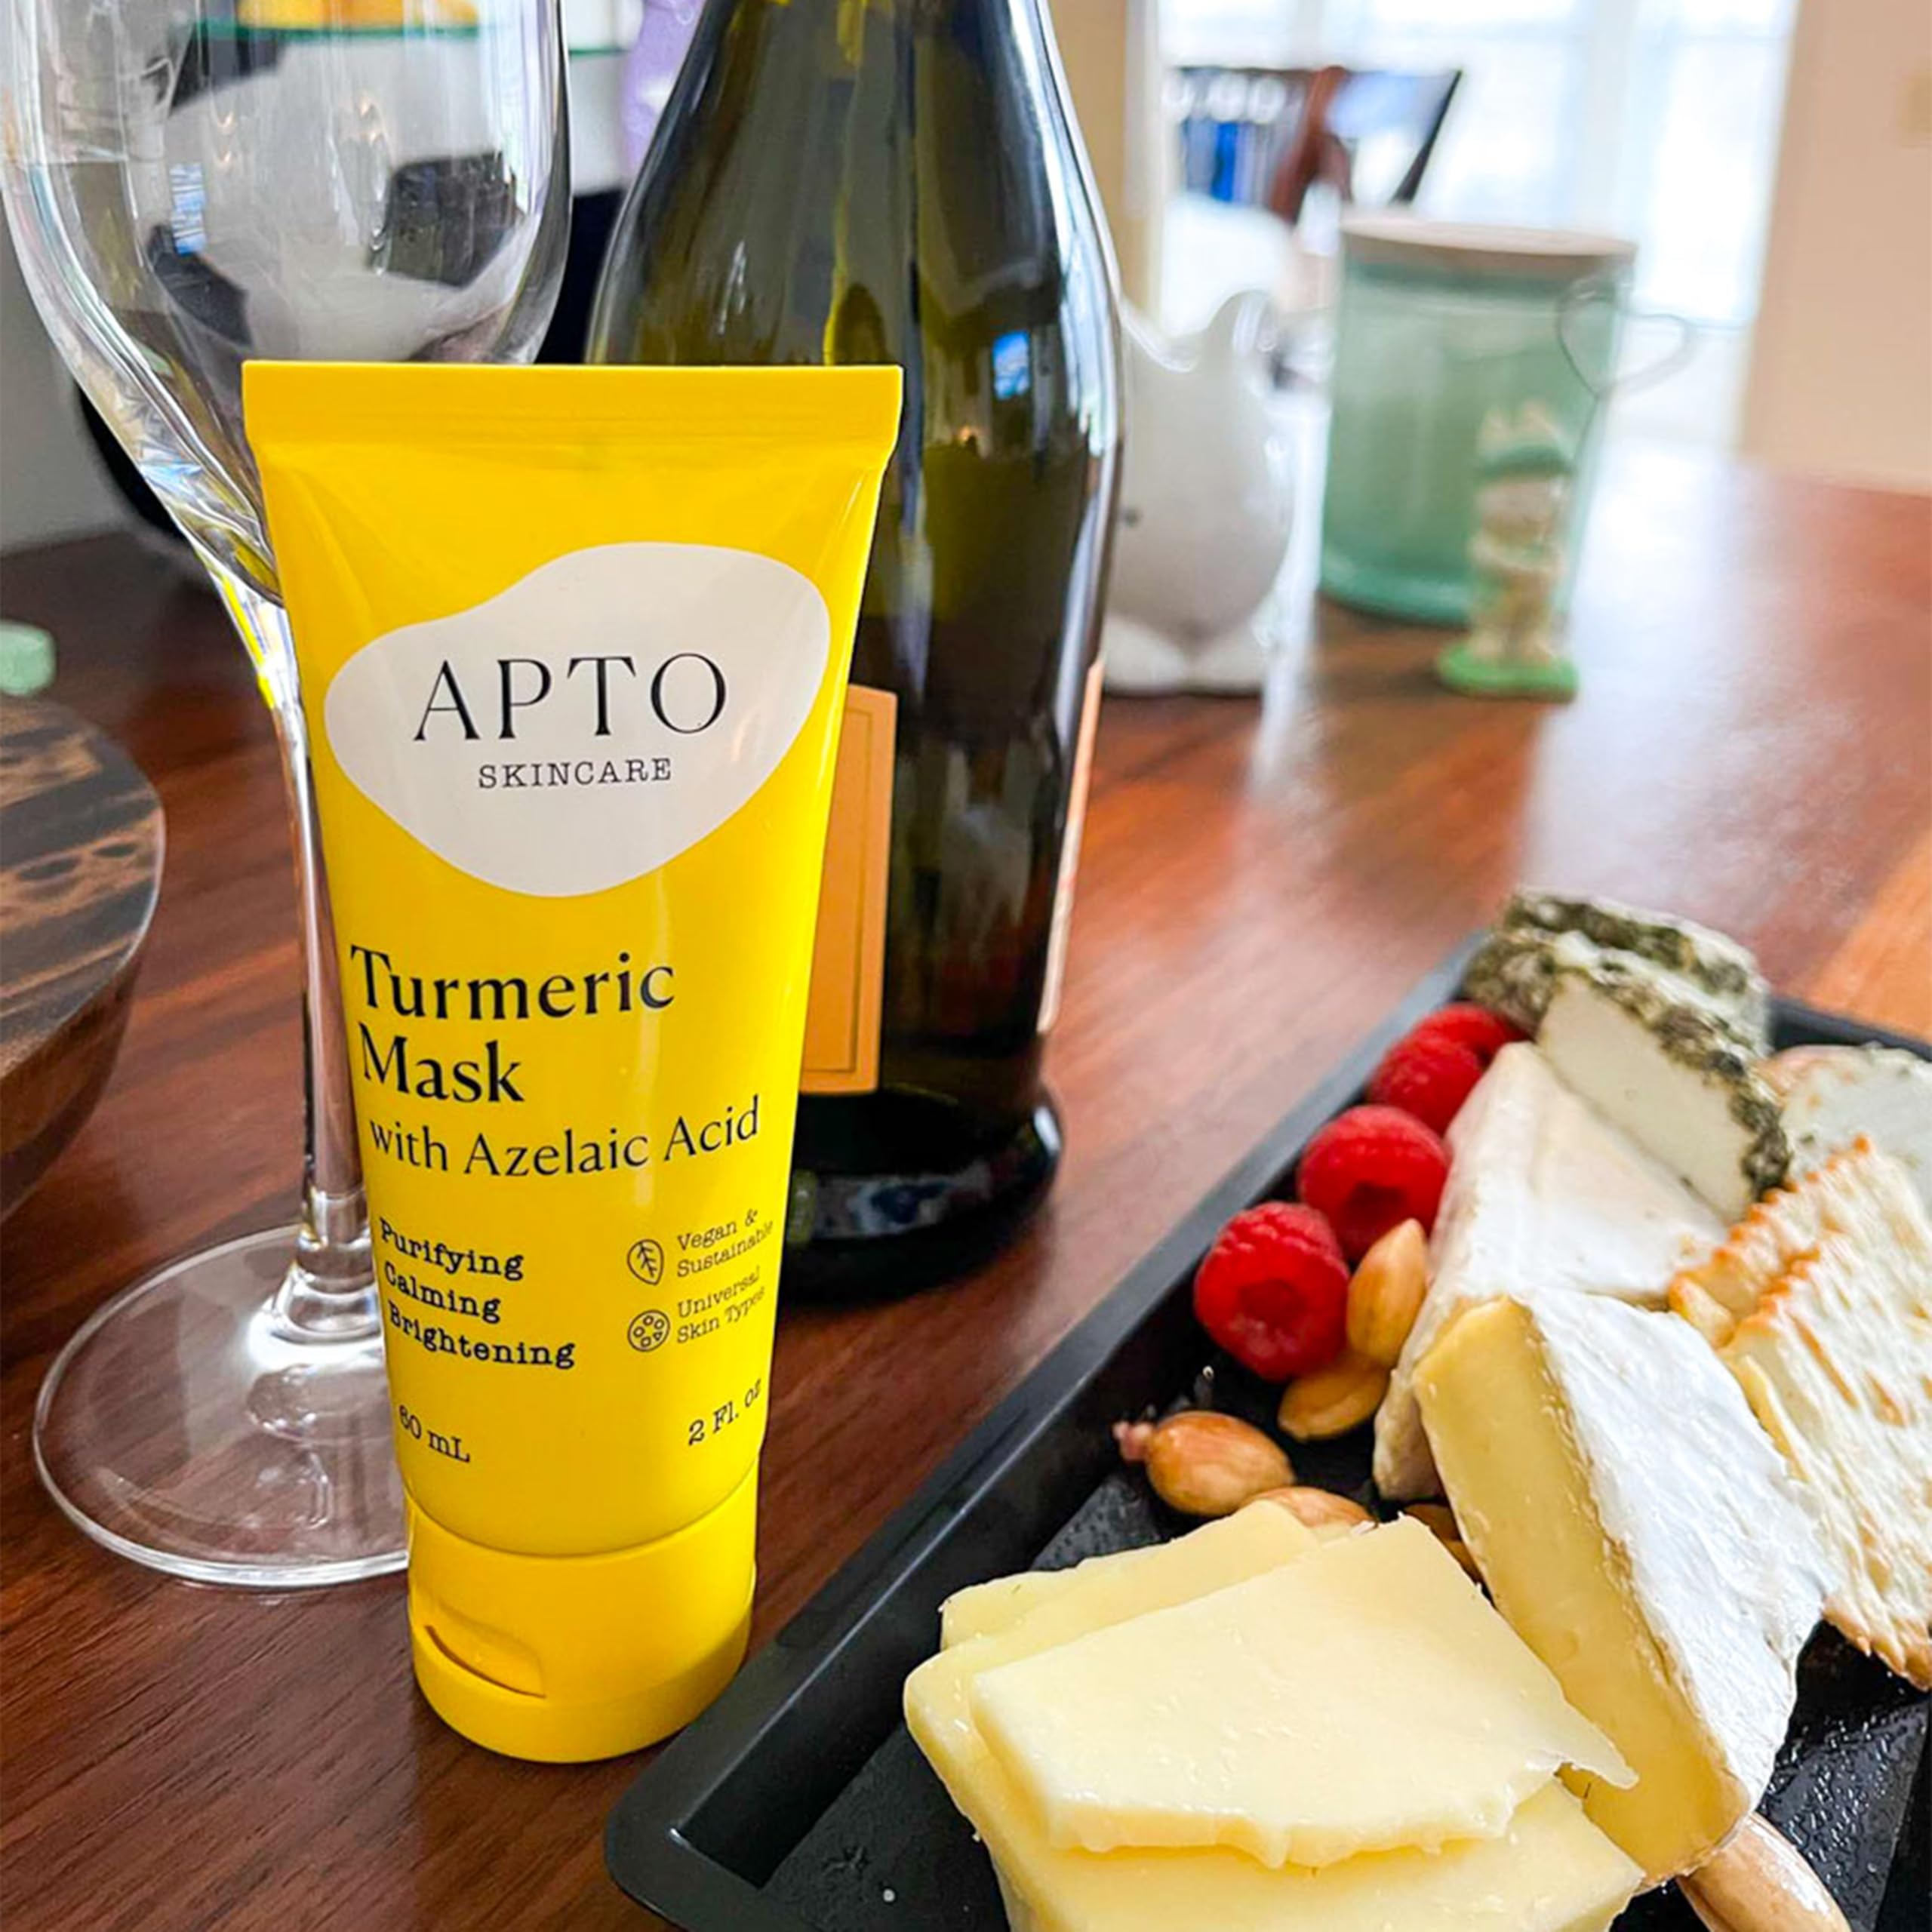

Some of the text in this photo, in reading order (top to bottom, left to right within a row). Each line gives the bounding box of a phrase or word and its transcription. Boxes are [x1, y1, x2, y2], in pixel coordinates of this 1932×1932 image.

[413, 652, 726, 741] APTO
[478, 758, 672, 789] SKINCARE
[350, 944, 675, 1020] Turmeric
[358, 1021, 525, 1103] Mask
[369, 1094, 759, 1177] with Azelaic Acid
[380, 1217, 524, 1281] Purifying
[677, 1208, 758, 1251] Vegan &
[677, 1220, 774, 1278] Sustainable
[384, 1260, 501, 1324] Calming
[677, 1264, 761, 1318] Universal
[387, 1300, 576, 1370] Brightening
[677, 1317, 720, 1344] Skin
[398, 1404, 471, 1463] 60 mL
[688, 1419, 706, 1447] 2
[712, 1400, 740, 1435] Fl.
